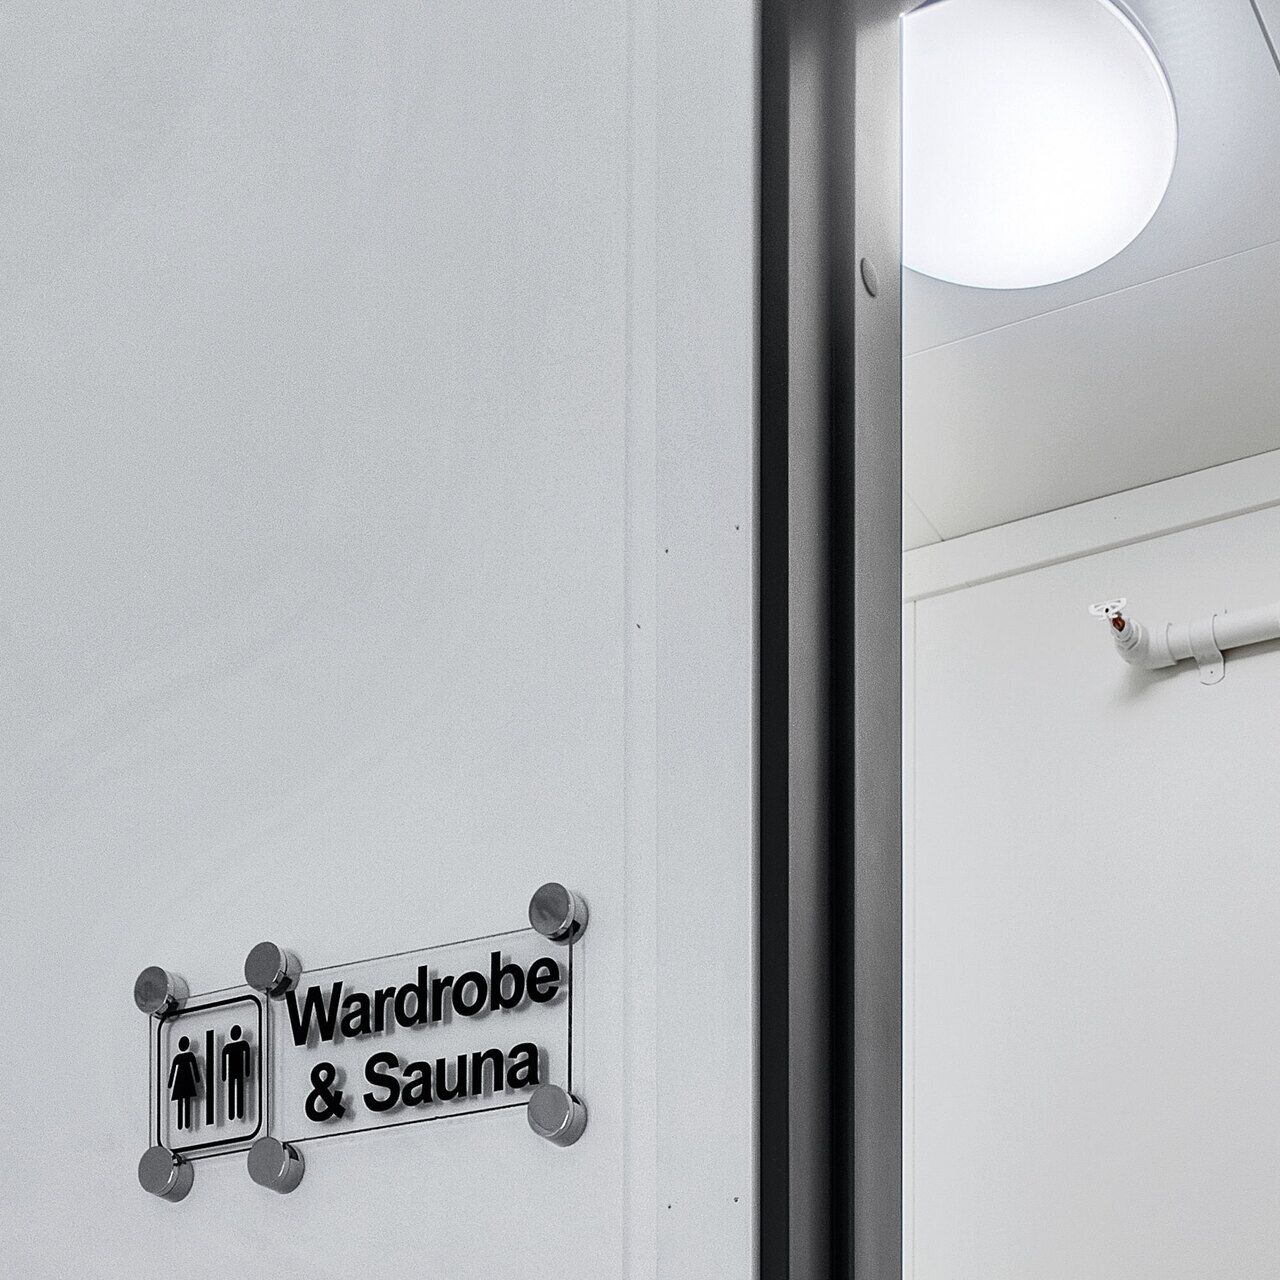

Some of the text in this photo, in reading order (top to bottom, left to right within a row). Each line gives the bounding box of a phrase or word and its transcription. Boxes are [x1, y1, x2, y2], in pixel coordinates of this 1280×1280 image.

[286, 952, 560, 1046] Wardrobe
[304, 1042, 540, 1122] & Sauna
